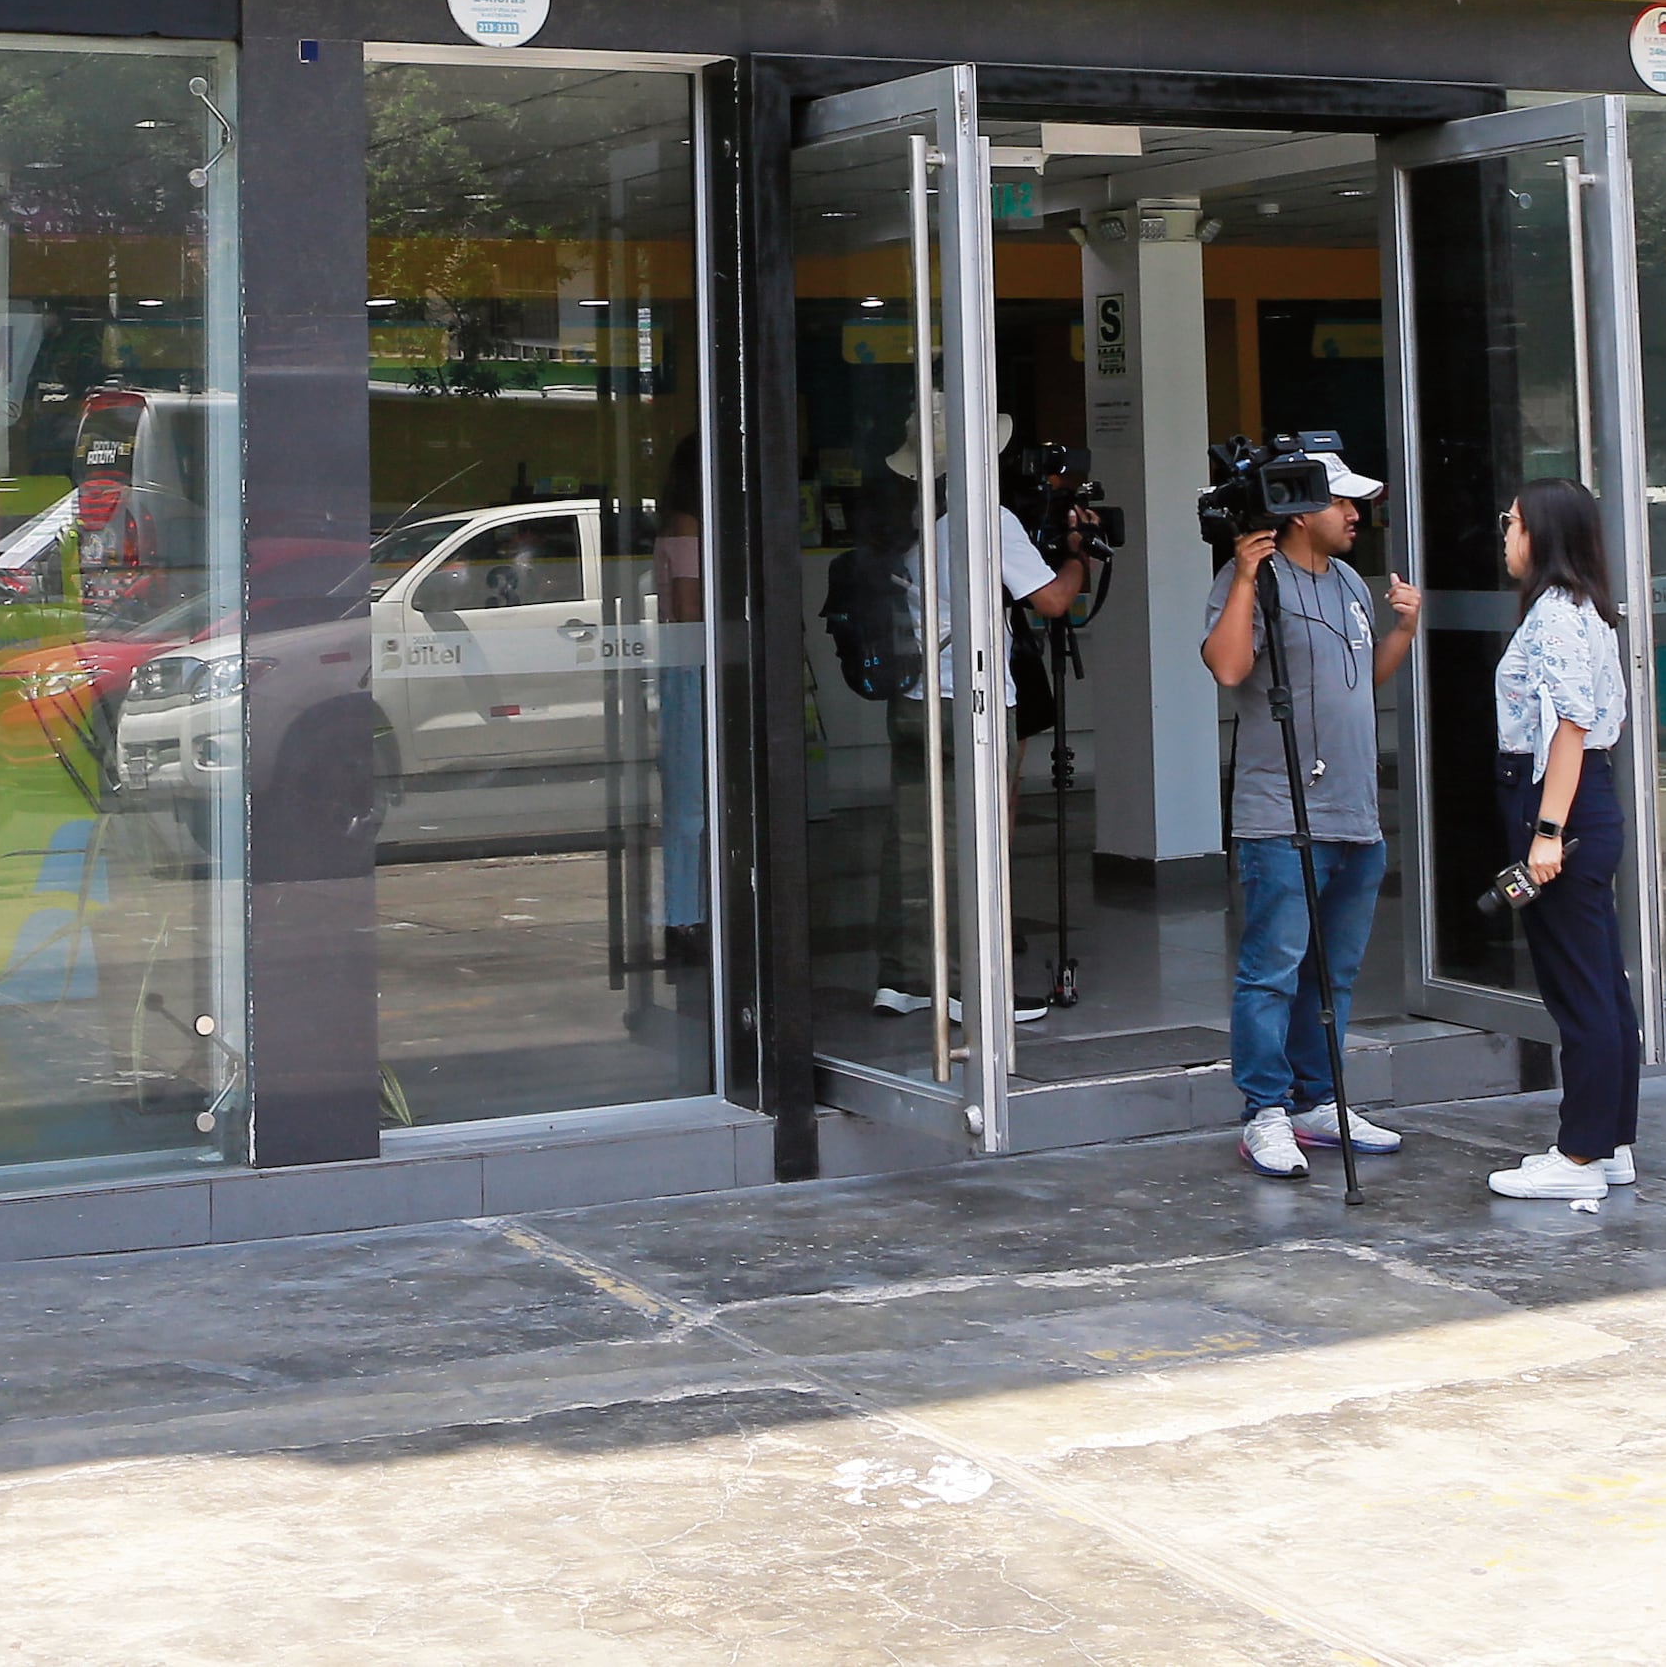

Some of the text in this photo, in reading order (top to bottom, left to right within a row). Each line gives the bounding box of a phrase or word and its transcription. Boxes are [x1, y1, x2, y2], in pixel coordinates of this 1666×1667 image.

[1099, 298, 1122, 343] S
[407, 644, 462, 665] bitel
[600, 638, 647, 658] bite
